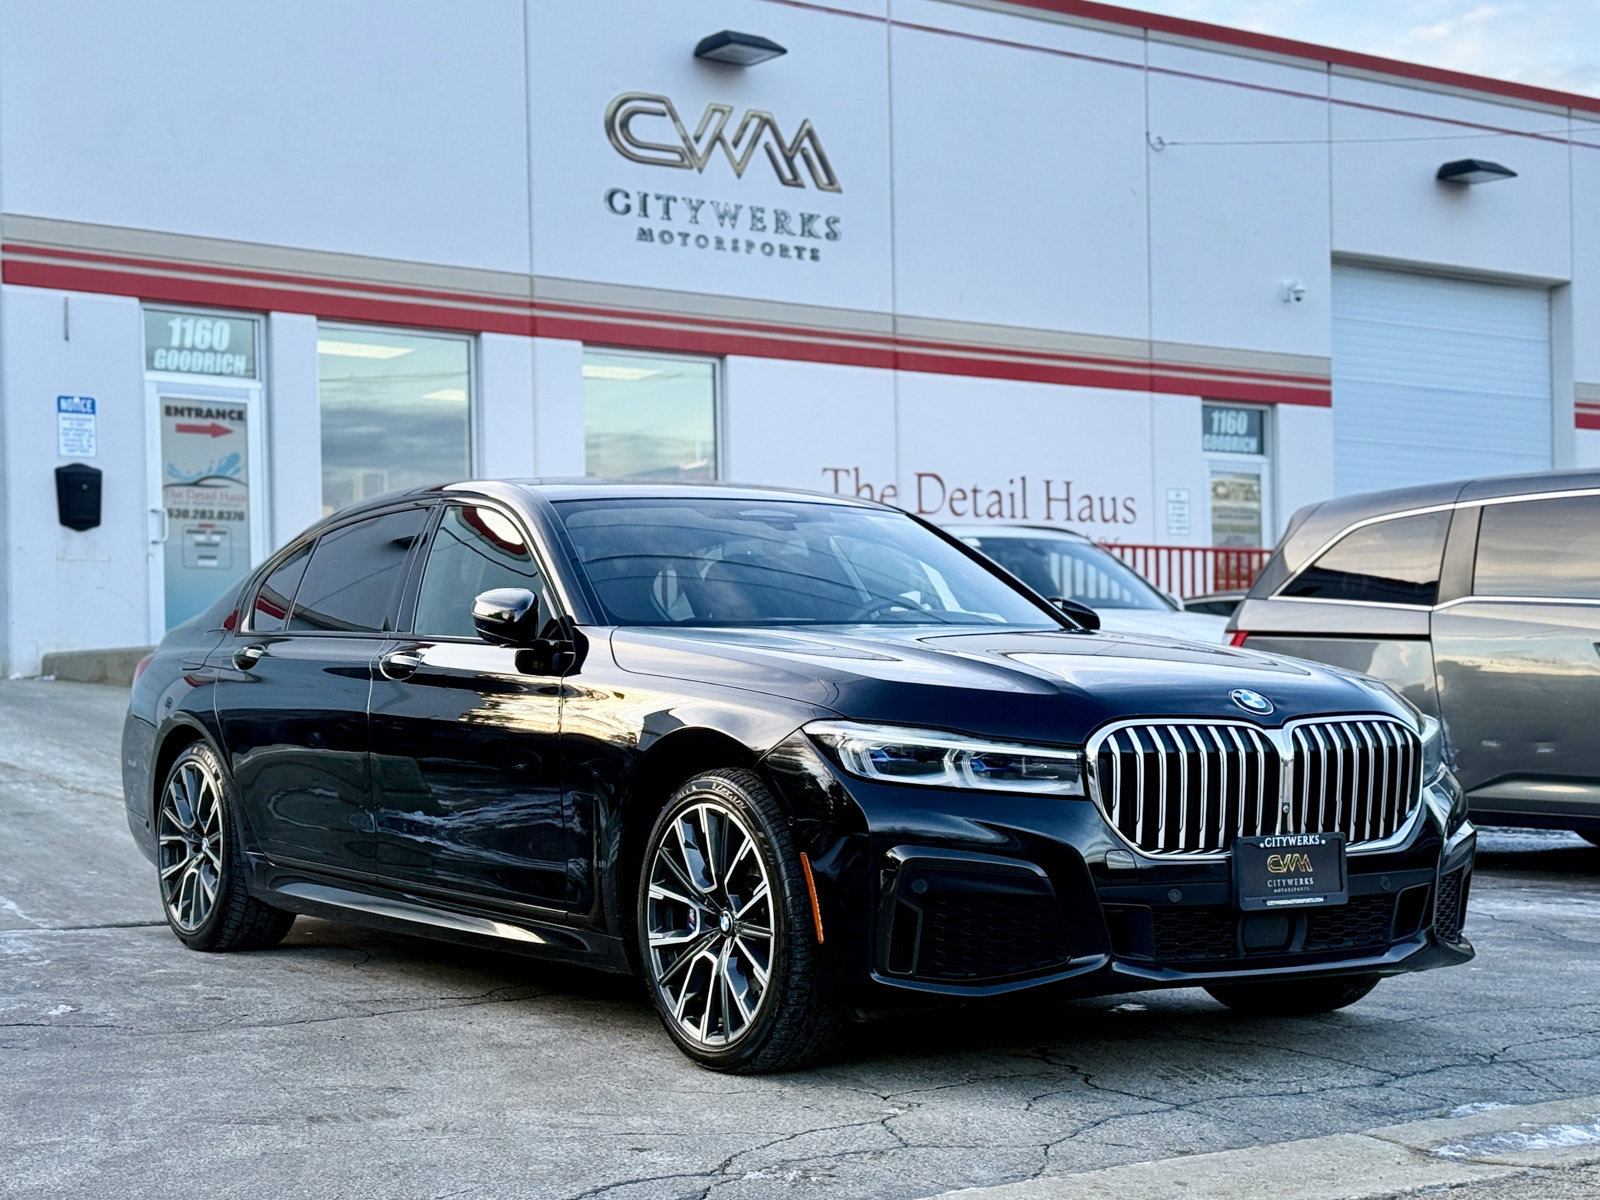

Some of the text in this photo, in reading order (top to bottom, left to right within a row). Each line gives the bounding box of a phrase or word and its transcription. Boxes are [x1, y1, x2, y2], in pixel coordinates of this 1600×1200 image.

[604, 187, 843, 242] CITYWERKS
[636, 227, 821, 262] MOTORSPORTS
[168, 316, 231, 351] 1160
[153, 348, 247, 376] GOODRICH
[60, 398, 93, 412] NOTICE
[164, 405, 245, 421] ENTRANCE
[1211, 409, 1248, 435] 1160
[187, 489, 217, 501] Detail
[822, 468, 898, 505] The
[914, 473, 1028, 520] Detail
[1044, 479, 1137, 525] Haus
[1265, 835, 1319, 847] CITYWERKS
[1267, 877, 1313, 887] CITYWERKS
